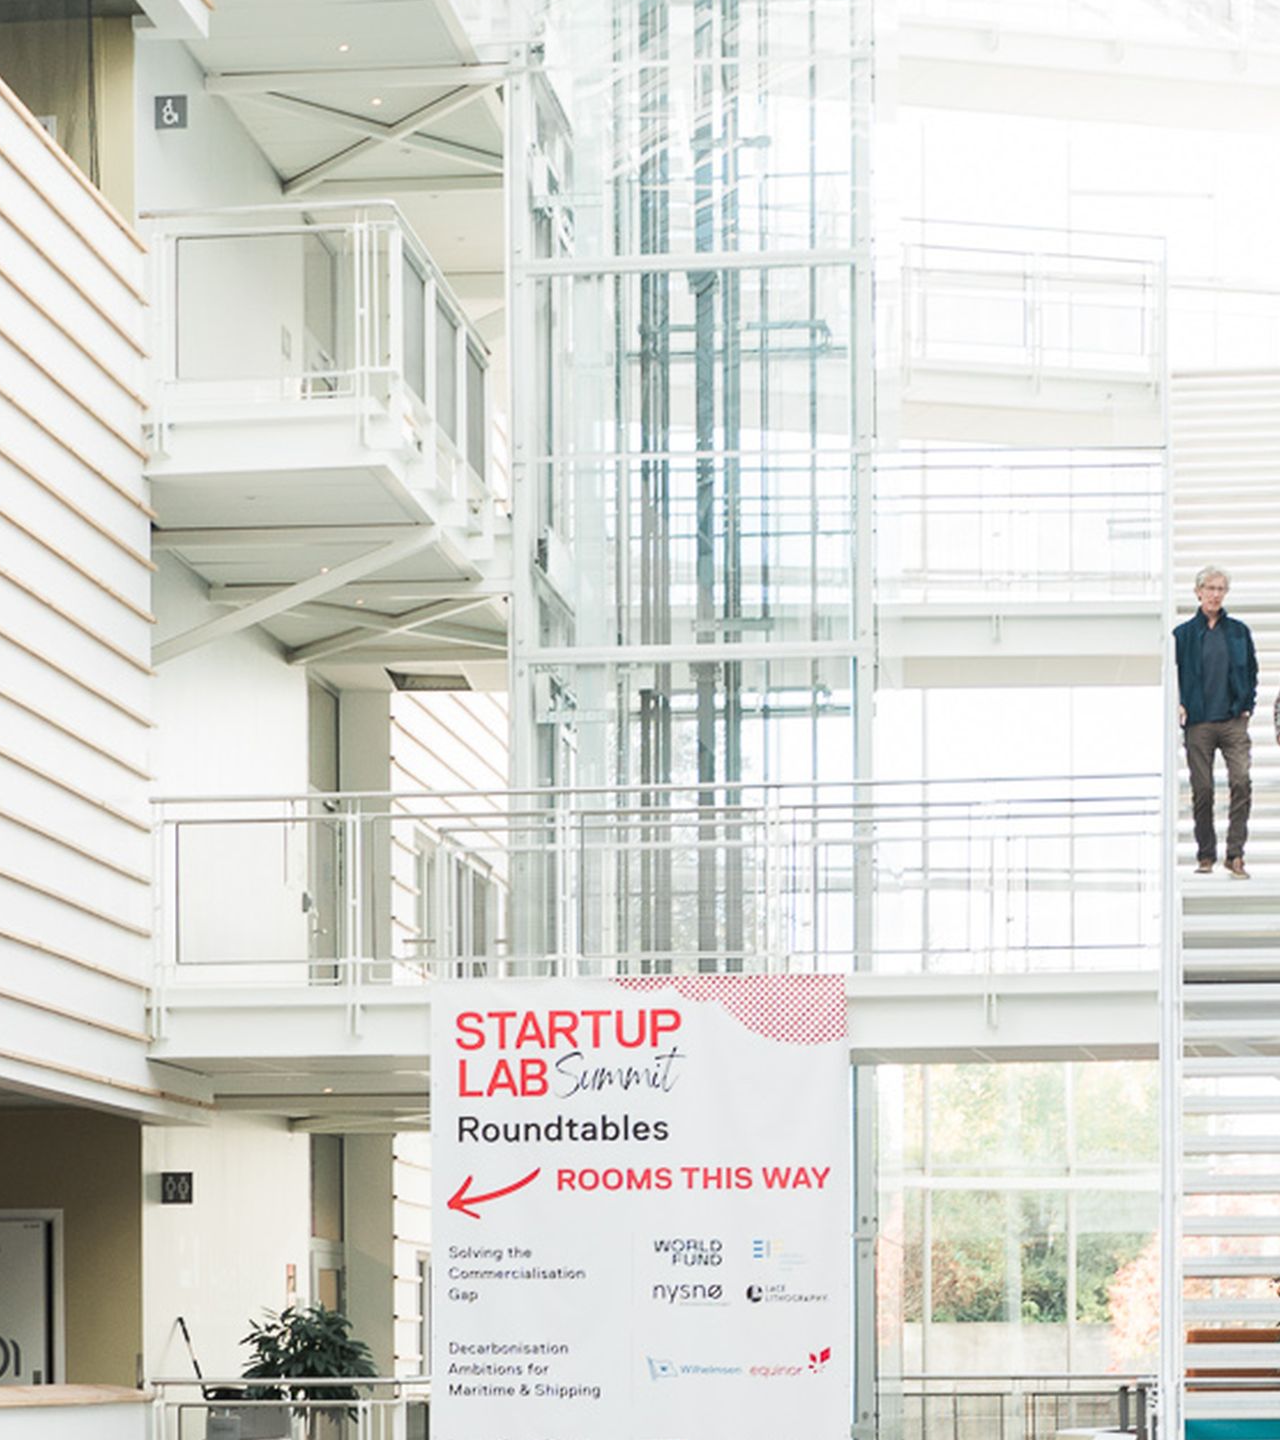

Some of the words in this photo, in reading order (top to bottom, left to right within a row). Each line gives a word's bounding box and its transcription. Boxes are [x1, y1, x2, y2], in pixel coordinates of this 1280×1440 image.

[455, 1008, 682, 1051] STARTUP
[457, 1058, 549, 1098] LAB
[554, 1046, 686, 1099] Summit
[457, 1114, 669, 1143] Roundtables
[556, 1167, 673, 1192] ROOMS
[680, 1167, 753, 1191] THIS
[761, 1166, 832, 1190] WAY
[448, 1245, 503, 1262] Solving
[507, 1246, 532, 1259] the
[653, 1239, 723, 1253] WORLD
[672, 1253, 723, 1266] FUND
[448, 1266, 587, 1280] Commercialisation
[448, 1287, 479, 1303] Gap
[652, 1283, 723, 1304] nysnø
[448, 1341, 569, 1356] Decarbonisation
[448, 1362, 523, 1376] Ambitions
[527, 1362, 550, 1376] for
[448, 1383, 516, 1397] Maritime
[519, 1383, 530, 1397] &
[534, 1383, 601, 1400] Shipping
